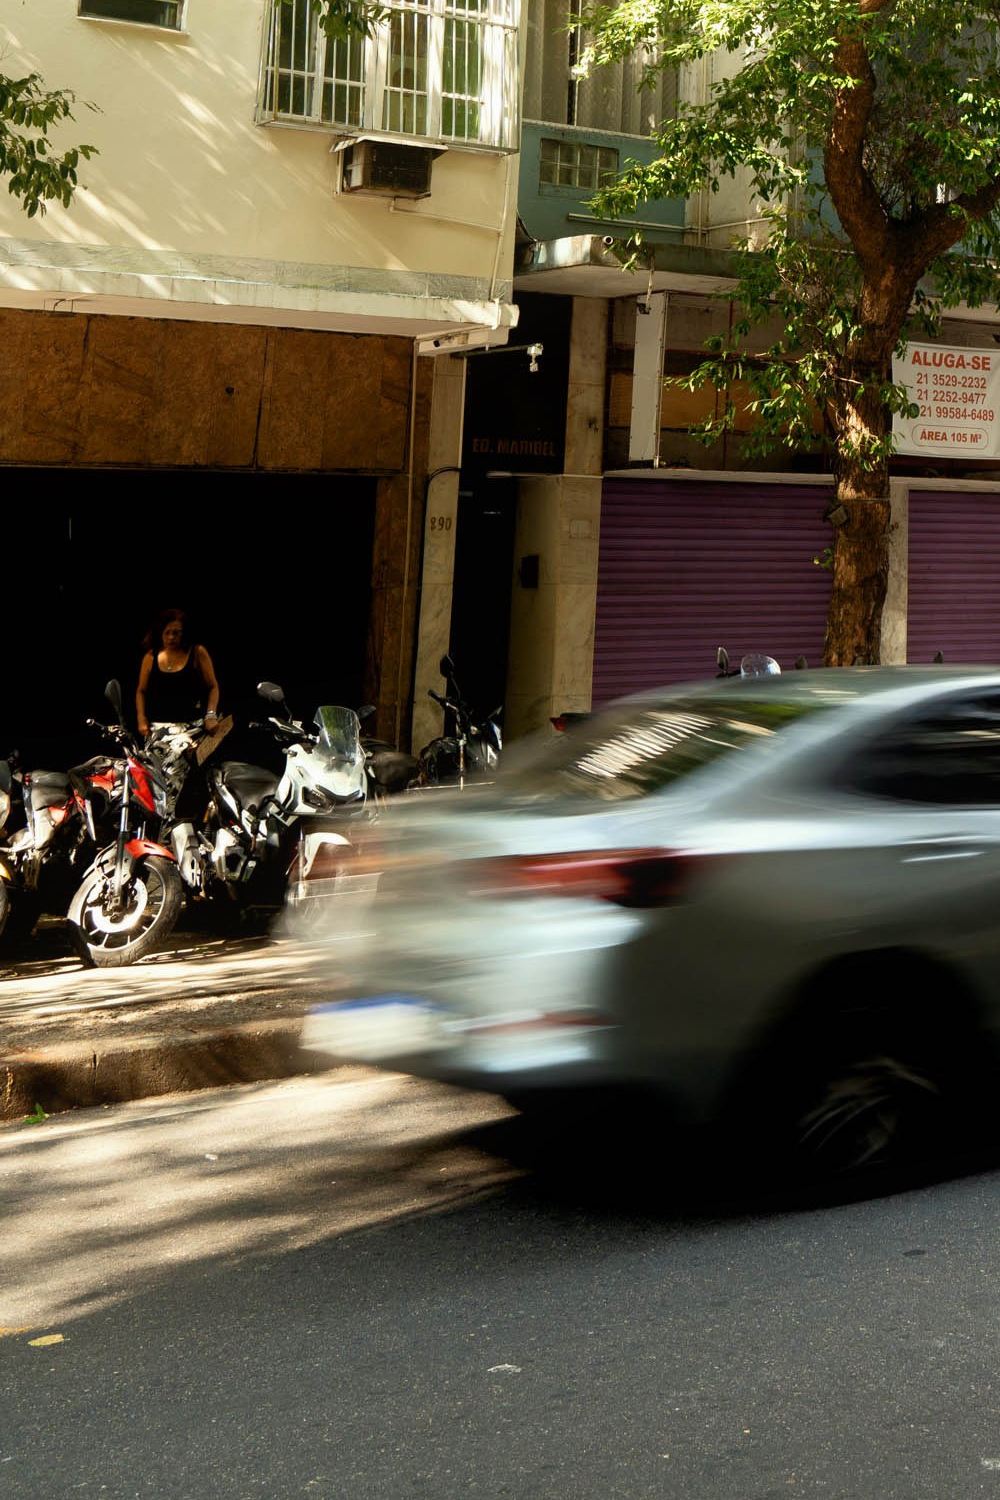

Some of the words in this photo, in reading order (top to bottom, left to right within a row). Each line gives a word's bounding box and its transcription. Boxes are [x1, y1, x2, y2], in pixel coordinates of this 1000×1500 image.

[911, 351, 991, 371] ALUGA-SE
[916, 372, 929, 385] 21
[932, 373, 987, 389] 3529-2232
[916, 388, 929, 401] 21
[932, 389, 987, 405] 2252-9477
[920, 405, 932, 418] 21
[935, 406, 995, 422] 99584-6489
[920, 428, 948, 442] ÁREA
[951, 432, 968, 443] 105
[970, 433, 982, 443] M²
